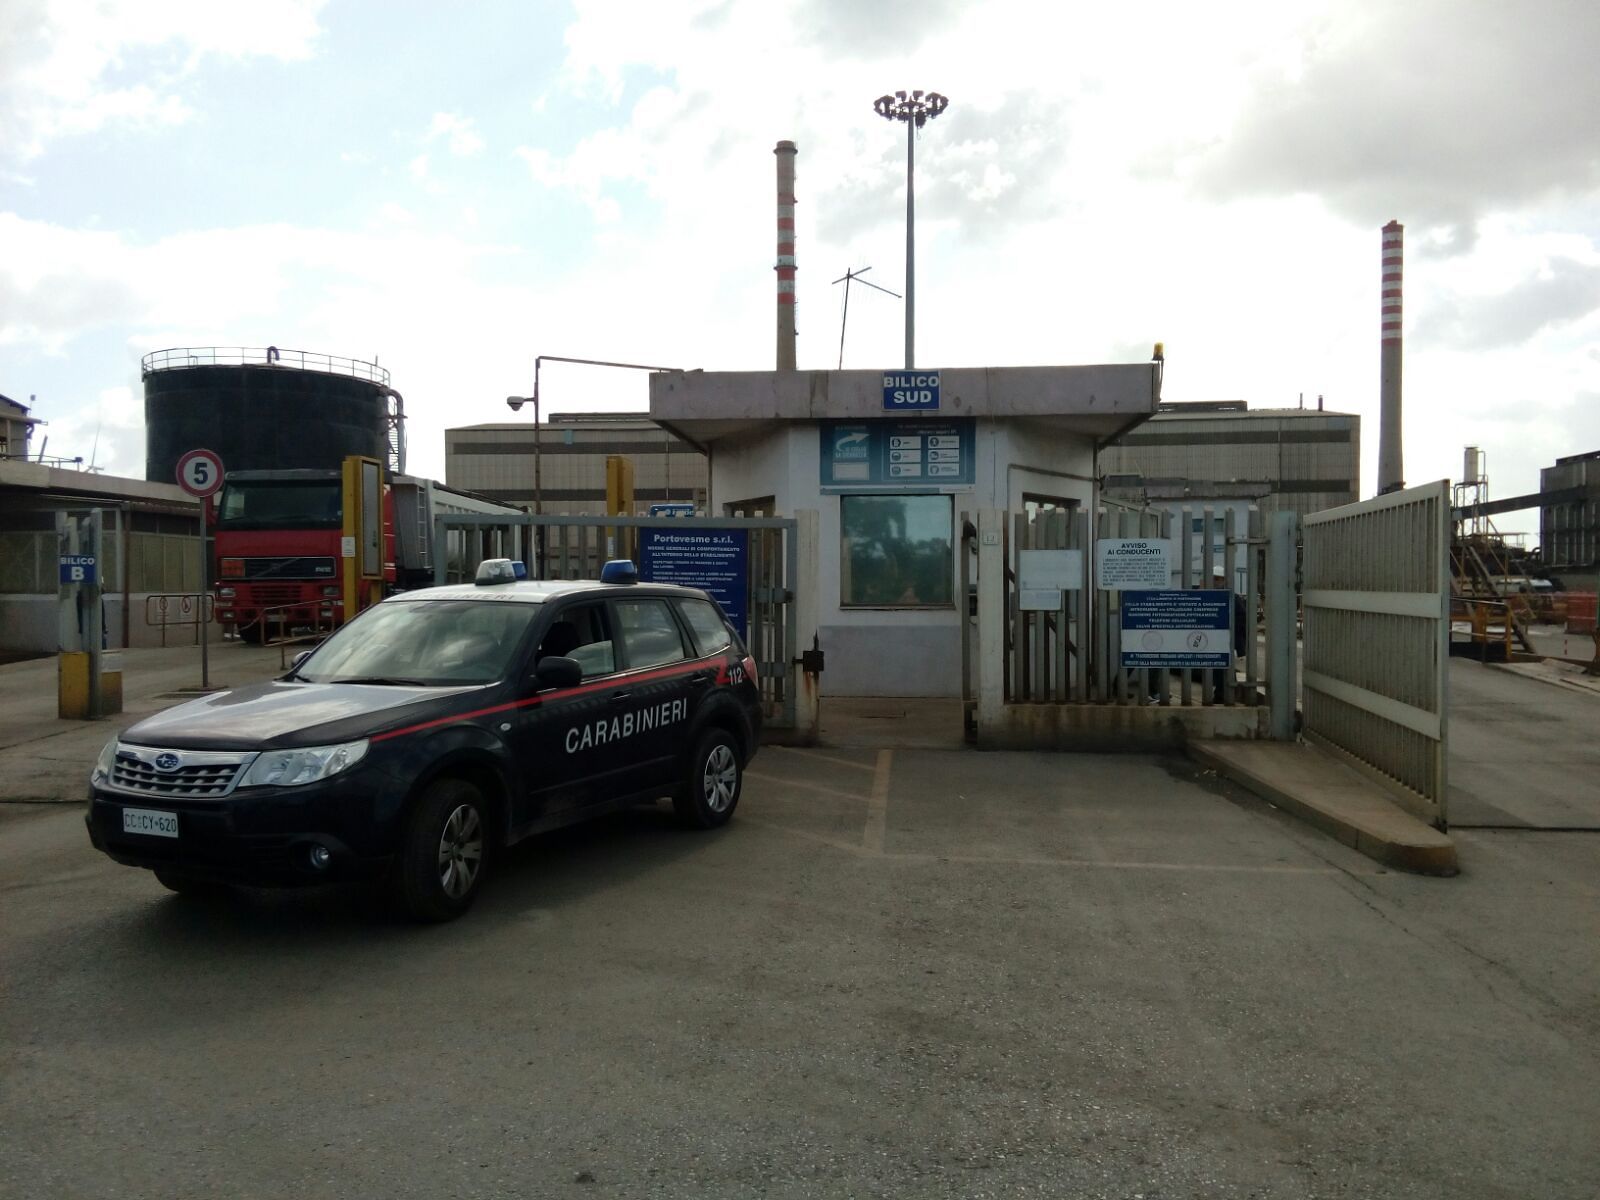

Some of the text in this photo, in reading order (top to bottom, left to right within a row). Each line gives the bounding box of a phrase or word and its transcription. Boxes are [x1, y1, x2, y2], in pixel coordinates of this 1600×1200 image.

[884, 376, 939, 387] BILICO
[894, 391, 931, 403] SUD
[193, 462, 208, 484] 5
[654, 534, 710, 543] Portovesme
[60, 557, 95, 565] BILICO
[71, 567, 84, 580] B
[729, 667, 743, 686] 112
[566, 698, 687, 753] CARABINIERI
